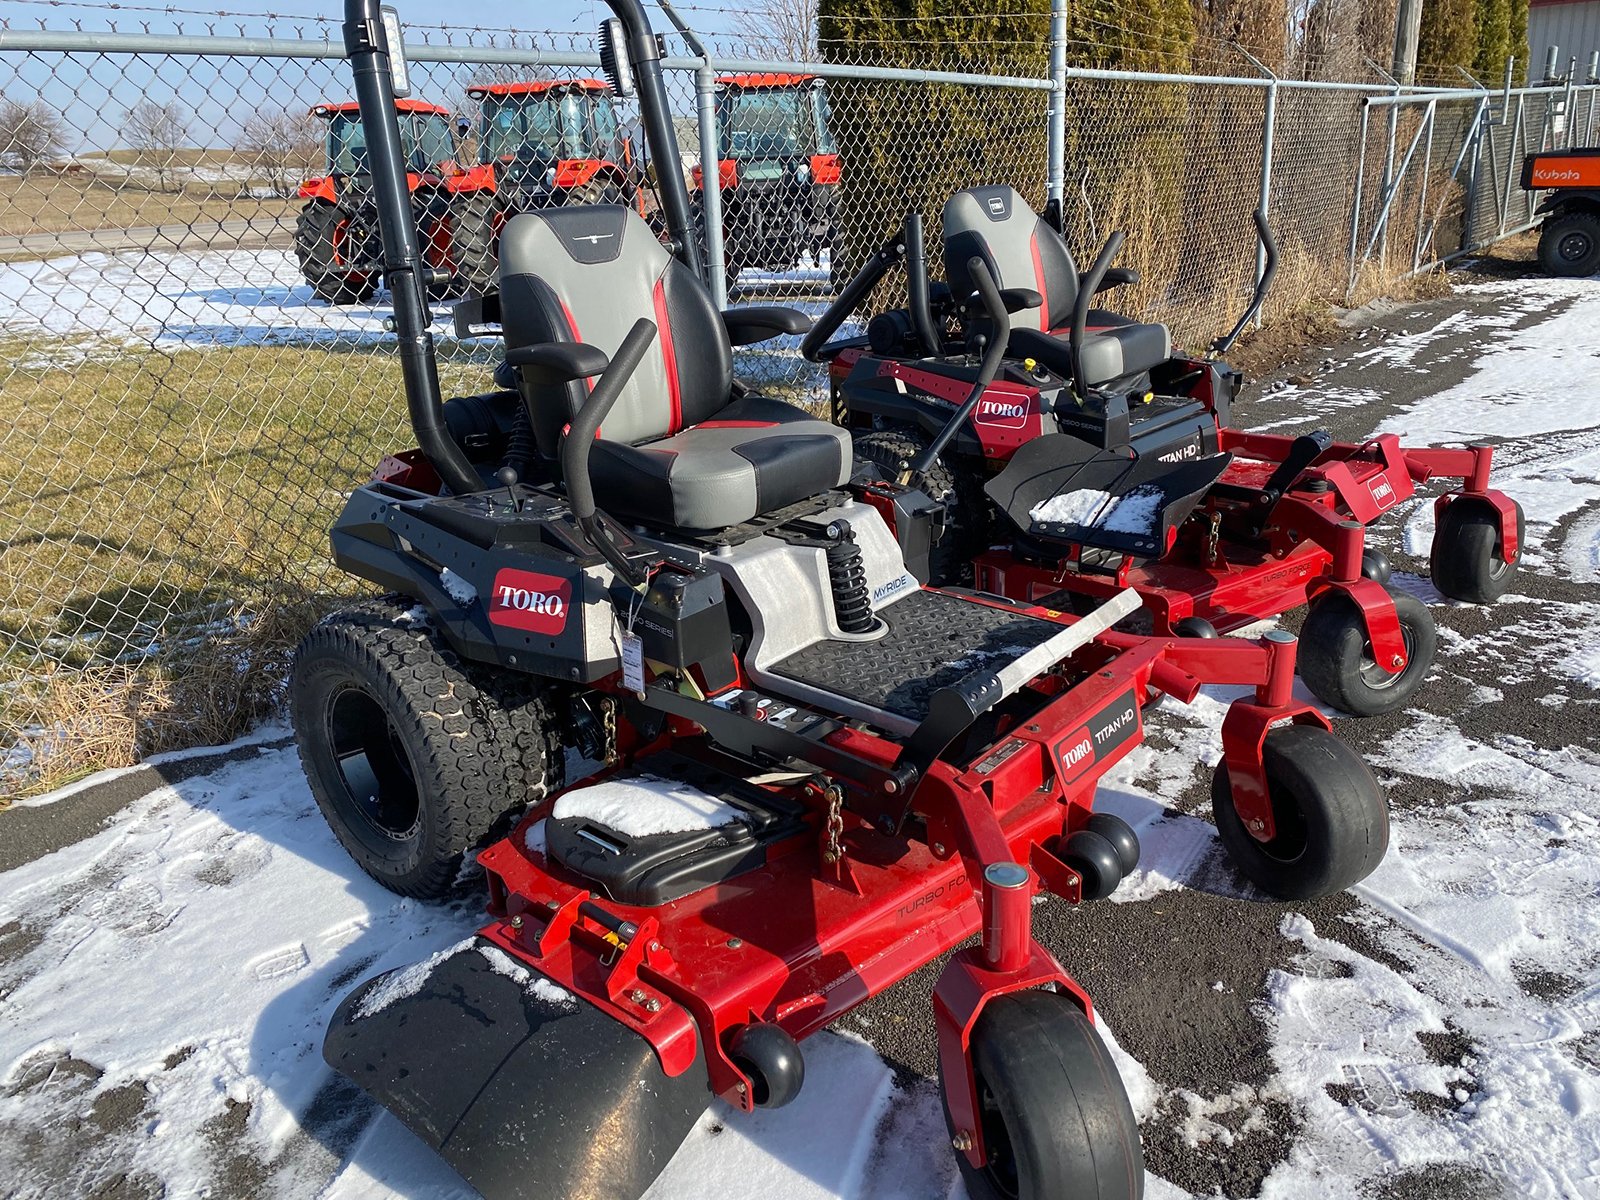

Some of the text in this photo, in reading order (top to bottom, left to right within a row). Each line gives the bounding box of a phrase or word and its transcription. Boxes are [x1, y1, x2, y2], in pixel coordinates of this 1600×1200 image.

[1535, 169, 1580, 180] Kubota
[982, 401, 1023, 418] TORO
[1183, 444, 1196, 459] HD
[1373, 482, 1392, 500] TORO
[1263, 570, 1287, 583] TURBO
[499, 585, 563, 616] TORO
[644, 620, 673, 638] SERIES
[1063, 708, 1134, 769] TORO TITAN HD
[898, 886, 944, 917] TURBO
